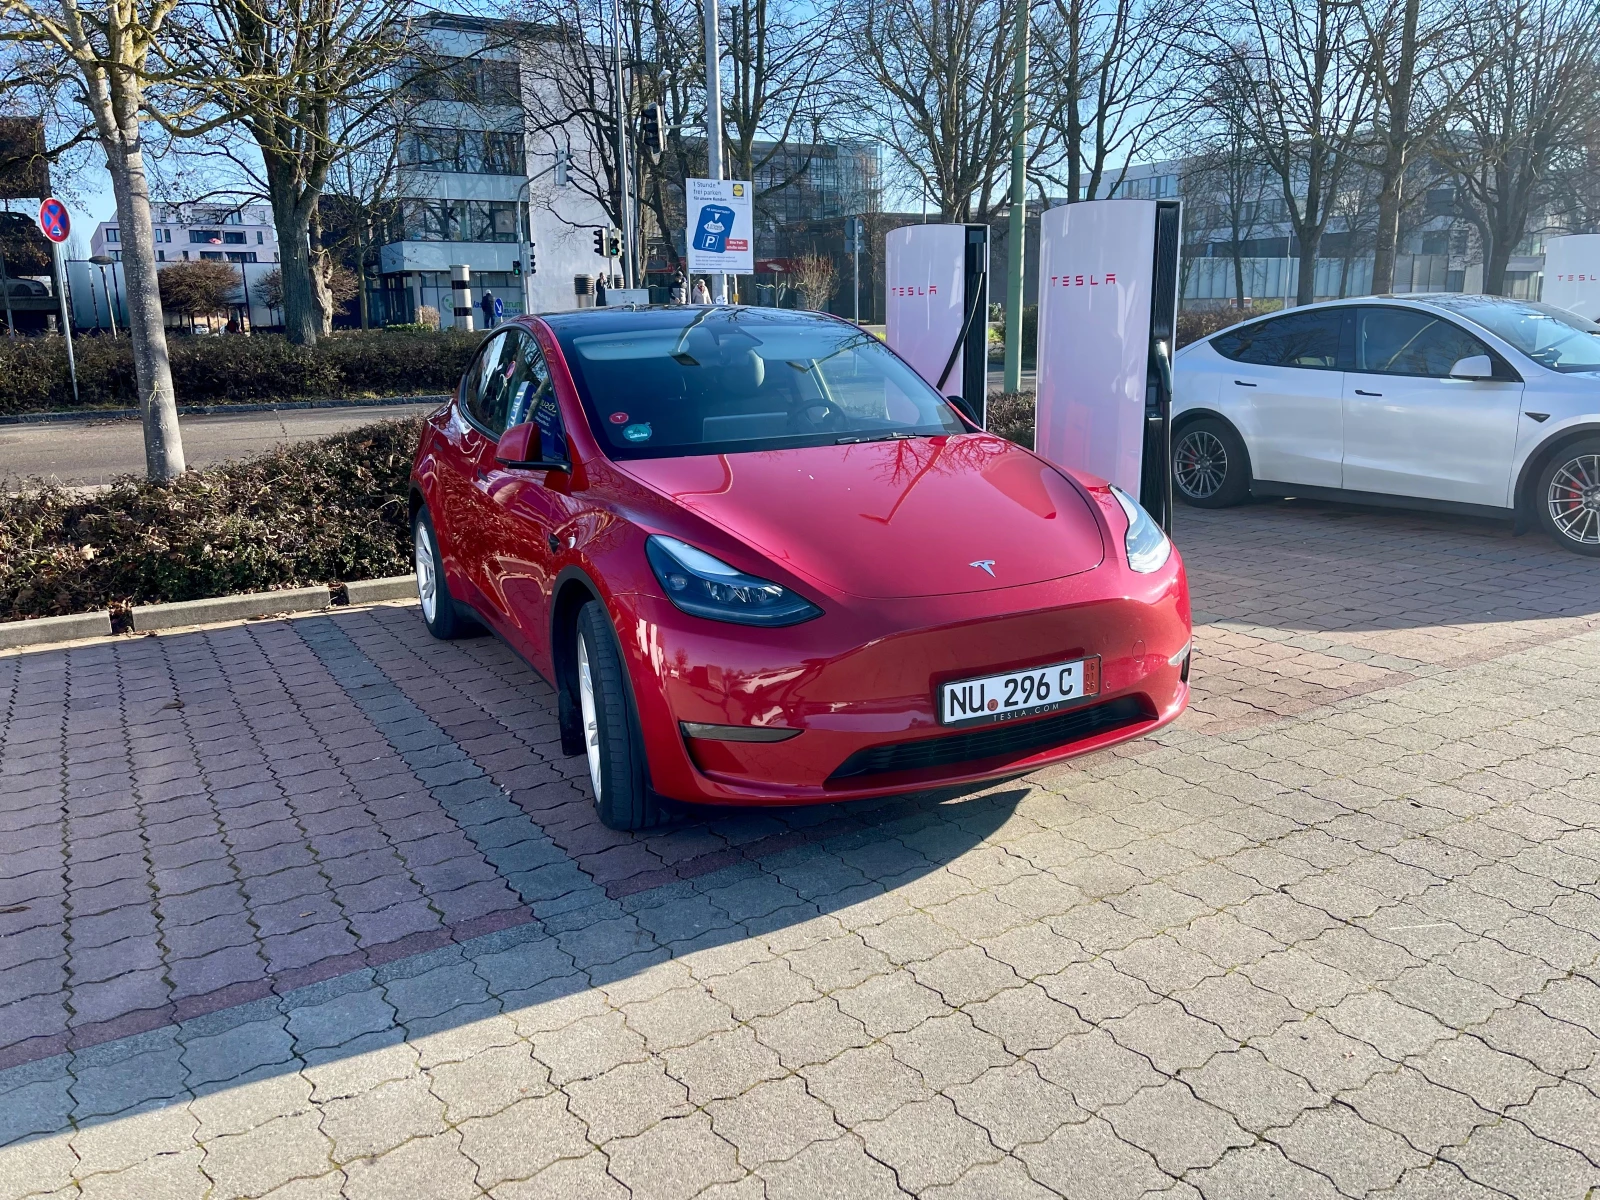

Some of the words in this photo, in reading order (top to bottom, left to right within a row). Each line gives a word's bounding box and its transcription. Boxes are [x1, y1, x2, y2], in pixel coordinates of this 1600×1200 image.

[705, 236, 715, 247] P
[1051, 273, 1116, 287] TESLA
[891, 285, 937, 297] TESLA
[950, 683, 985, 717] NU
[1004, 672, 1051, 708] 296
[1059, 667, 1074, 696] C
[993, 703, 1060, 722] TESLA.COM
